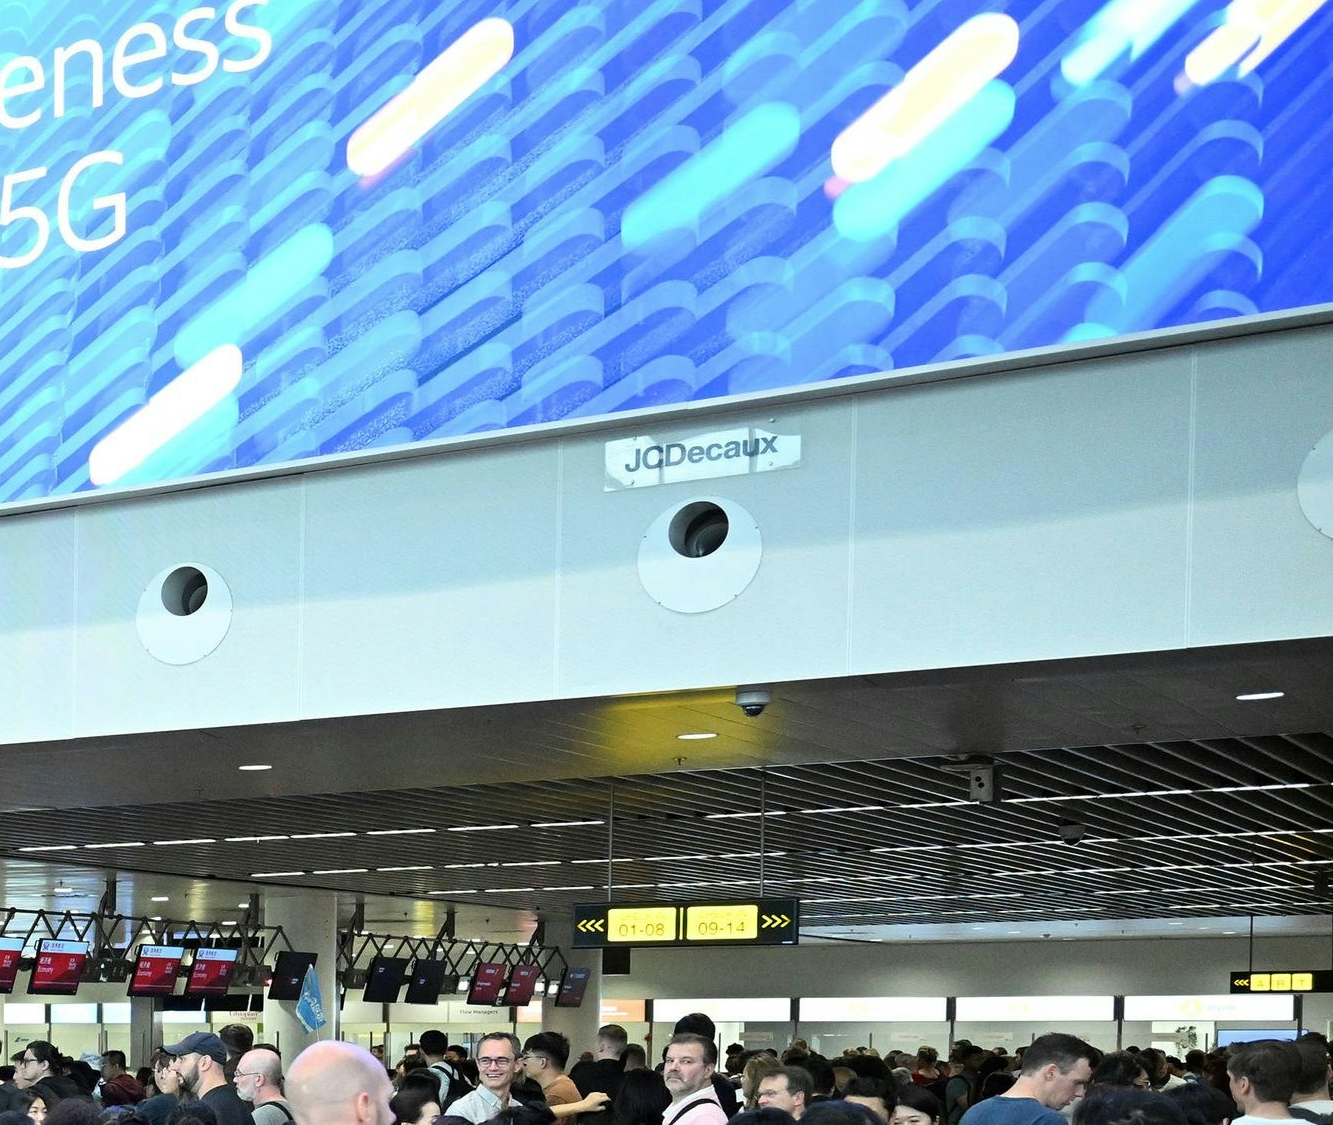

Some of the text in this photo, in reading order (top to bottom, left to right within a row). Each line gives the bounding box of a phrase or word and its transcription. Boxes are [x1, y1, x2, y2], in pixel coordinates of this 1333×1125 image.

[624, 436, 779, 473] JCDecaux
[618, 923, 665, 937] 01-08
[698, 920, 745, 936] 09-14
